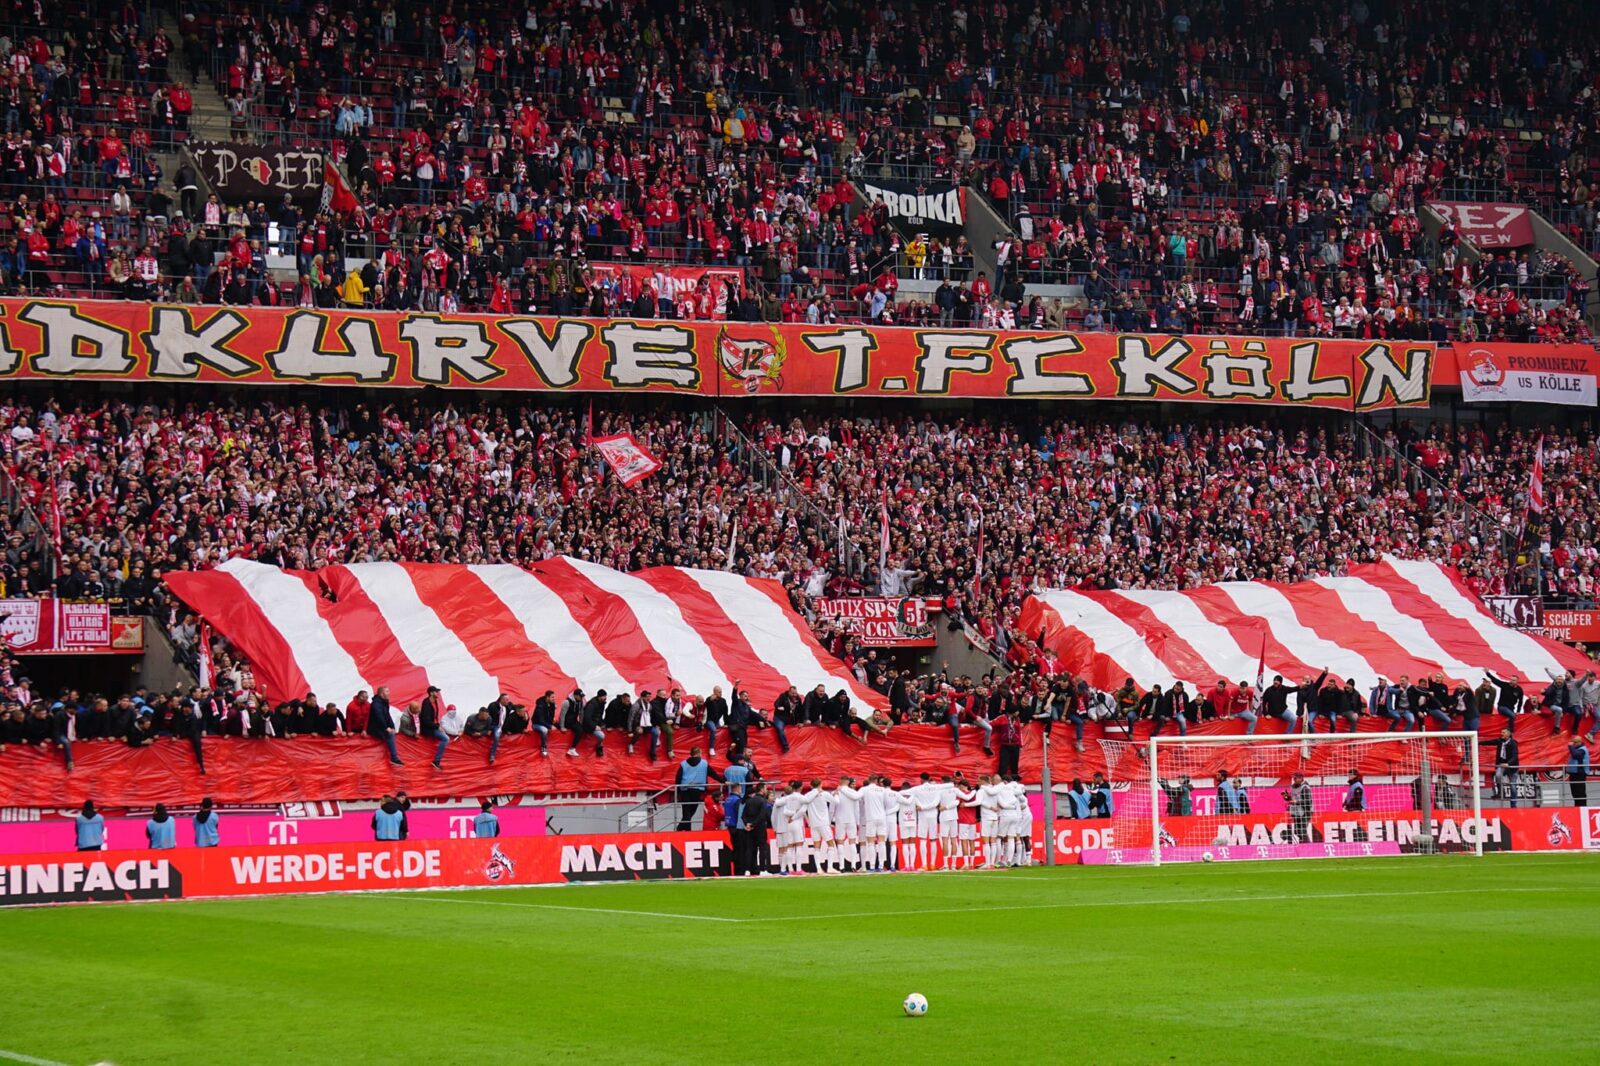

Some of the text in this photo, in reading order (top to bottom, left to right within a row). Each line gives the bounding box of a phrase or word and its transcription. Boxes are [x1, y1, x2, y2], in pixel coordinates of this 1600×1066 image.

[864, 184, 963, 226] TROIKA
[0, 302, 1430, 410] DKURVE 1.FC KÖLN
[741, 347, 764, 370] 12
[1508, 355, 1589, 373] PROMINENZ
[1539, 374, 1582, 392] KÖLLE
[1549, 611, 1592, 626] SCHÄFER
[1323, 821, 1358, 843] ET
[231, 849, 441, 885] WERDE-FC.DE
[560, 840, 724, 873] MACH ET
[0, 859, 169, 895] INFACH
